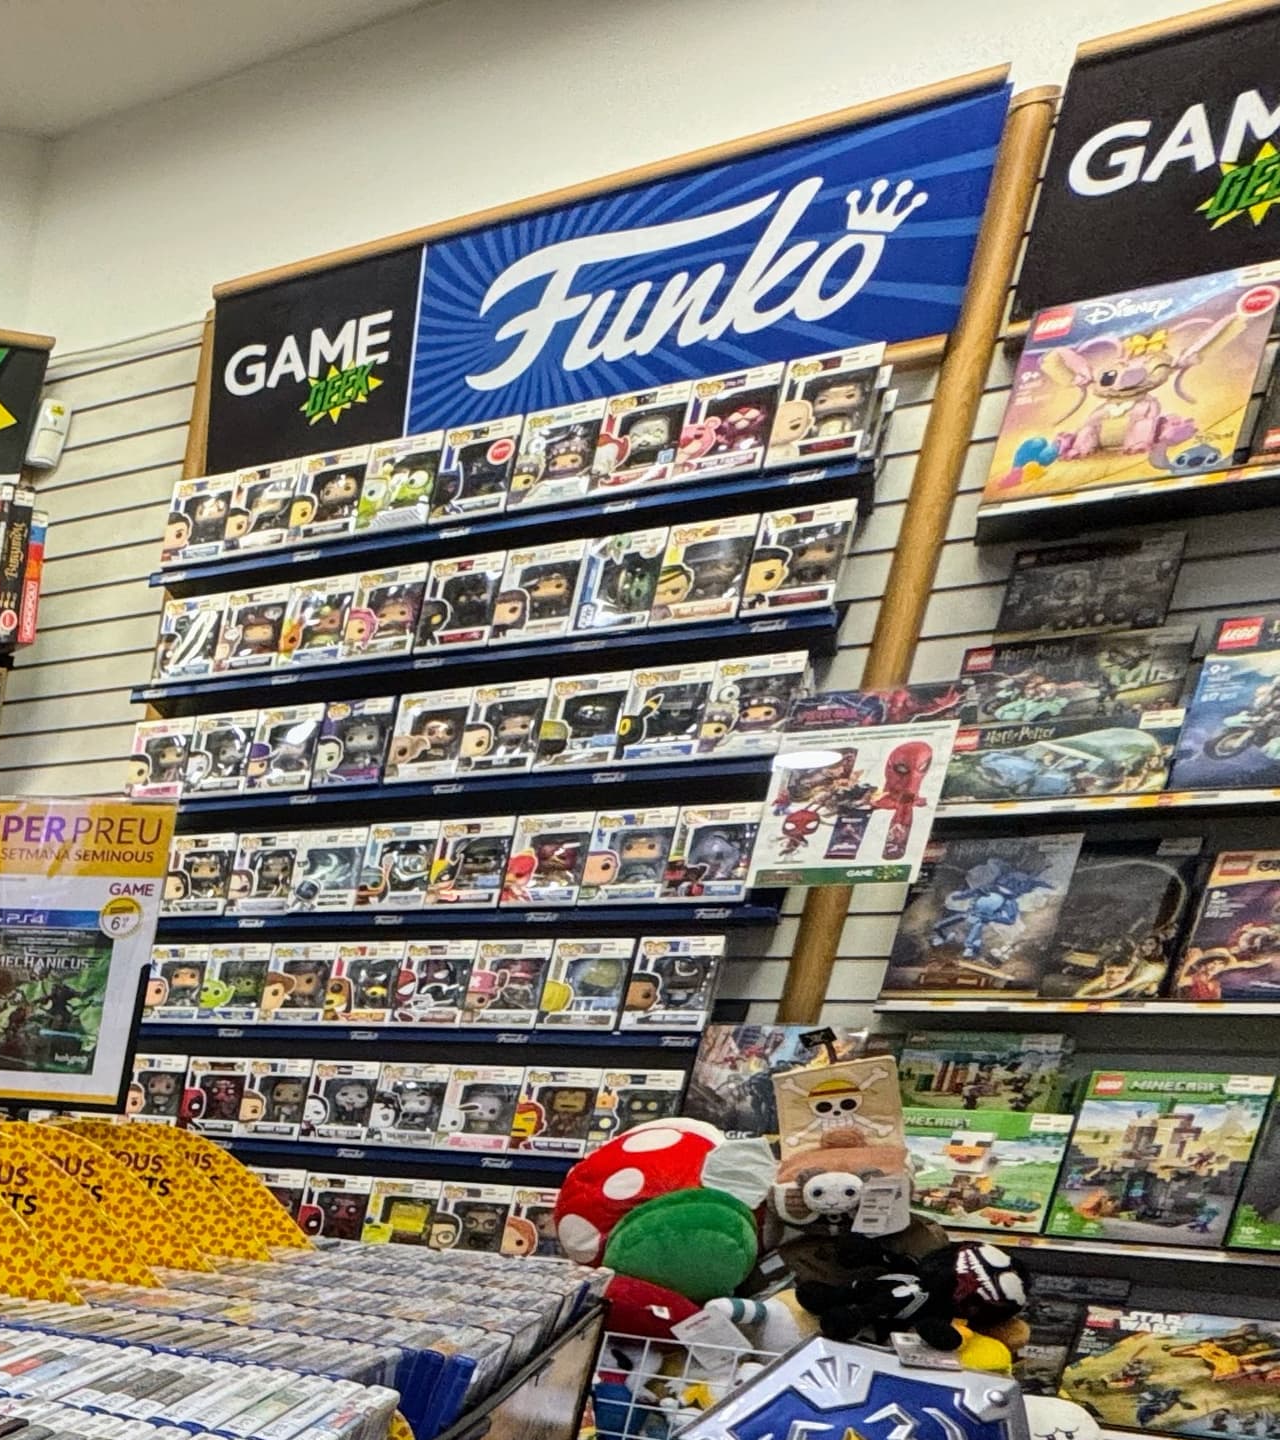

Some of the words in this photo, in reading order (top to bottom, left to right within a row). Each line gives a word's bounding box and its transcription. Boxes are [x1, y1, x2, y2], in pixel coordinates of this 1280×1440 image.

[465, 176, 886, 391] Funko
[224, 310, 393, 396] GAME
[306, 361, 374, 418] GEEK
[24, 581, 40, 639] MONOPOLY
[1221, 625, 1261, 642] LEGO
[1021, 725, 1055, 743] Potter
[74, 851, 154, 863] SEMINOUS
[847, 868, 875, 879] GAME
[109, 882, 155, 897] GAME
[6, 912, 46, 925] PS4
